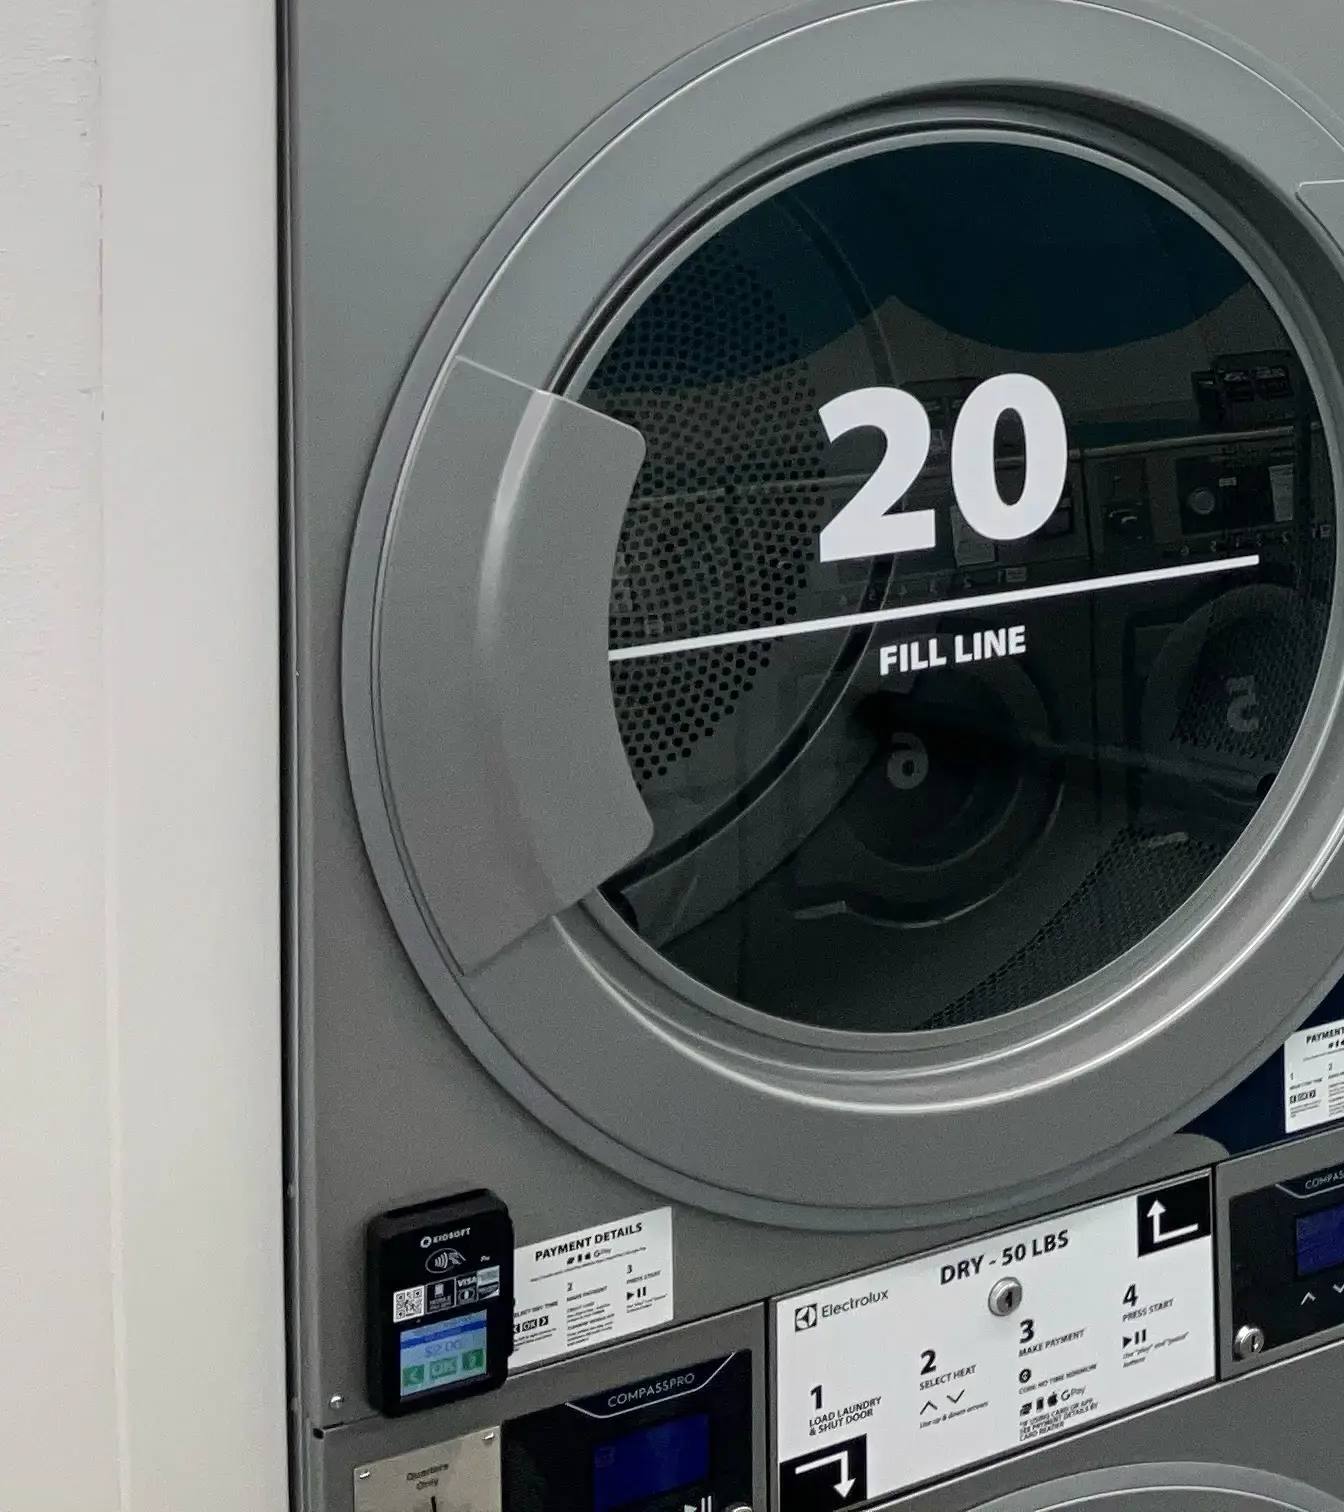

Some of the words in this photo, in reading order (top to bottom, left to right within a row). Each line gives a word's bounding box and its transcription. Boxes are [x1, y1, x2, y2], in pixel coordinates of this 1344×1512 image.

[818, 372, 1068, 562] 20
[880, 638, 947, 676] FILL
[954, 625, 1026, 664] LINE
[535, 1237, 591, 1262] PAYMENT
[594, 1222, 643, 1245] DETAILS
[940, 1254, 984, 1285] DRY
[1001, 1243, 1026, 1265] 50
[1031, 1229, 1069, 1258] LBS
[457, 1276, 477, 1288] VISA
[1122, 1283, 1139, 1307] 4
[821, 1289, 889, 1319] Electrolux
[1122, 1307, 1147, 1322] PRESS
[1148, 1296, 1175, 1314] START
[1018, 1342, 1043, 1358] MAKE
[1045, 1328, 1086, 1348] PAYMENT
[1019, 1319, 1035, 1344] 3
[920, 1350, 937, 1375] 2
[608, 1372, 695, 1407] COMPASSPRO
[920, 1373, 952, 1391] SELECT
[953, 1364, 977, 1382] HEAT
[810, 1385, 822, 1410] 1
[809, 1412, 835, 1428] LOAD
[838, 1396, 882, 1419] LAUNDRY
[809, 1427, 817, 1436] &
[818, 1418, 844, 1434] SHUT
[846, 1408, 873, 1425] DOOR
[406, 1462, 449, 1481] Quarters
